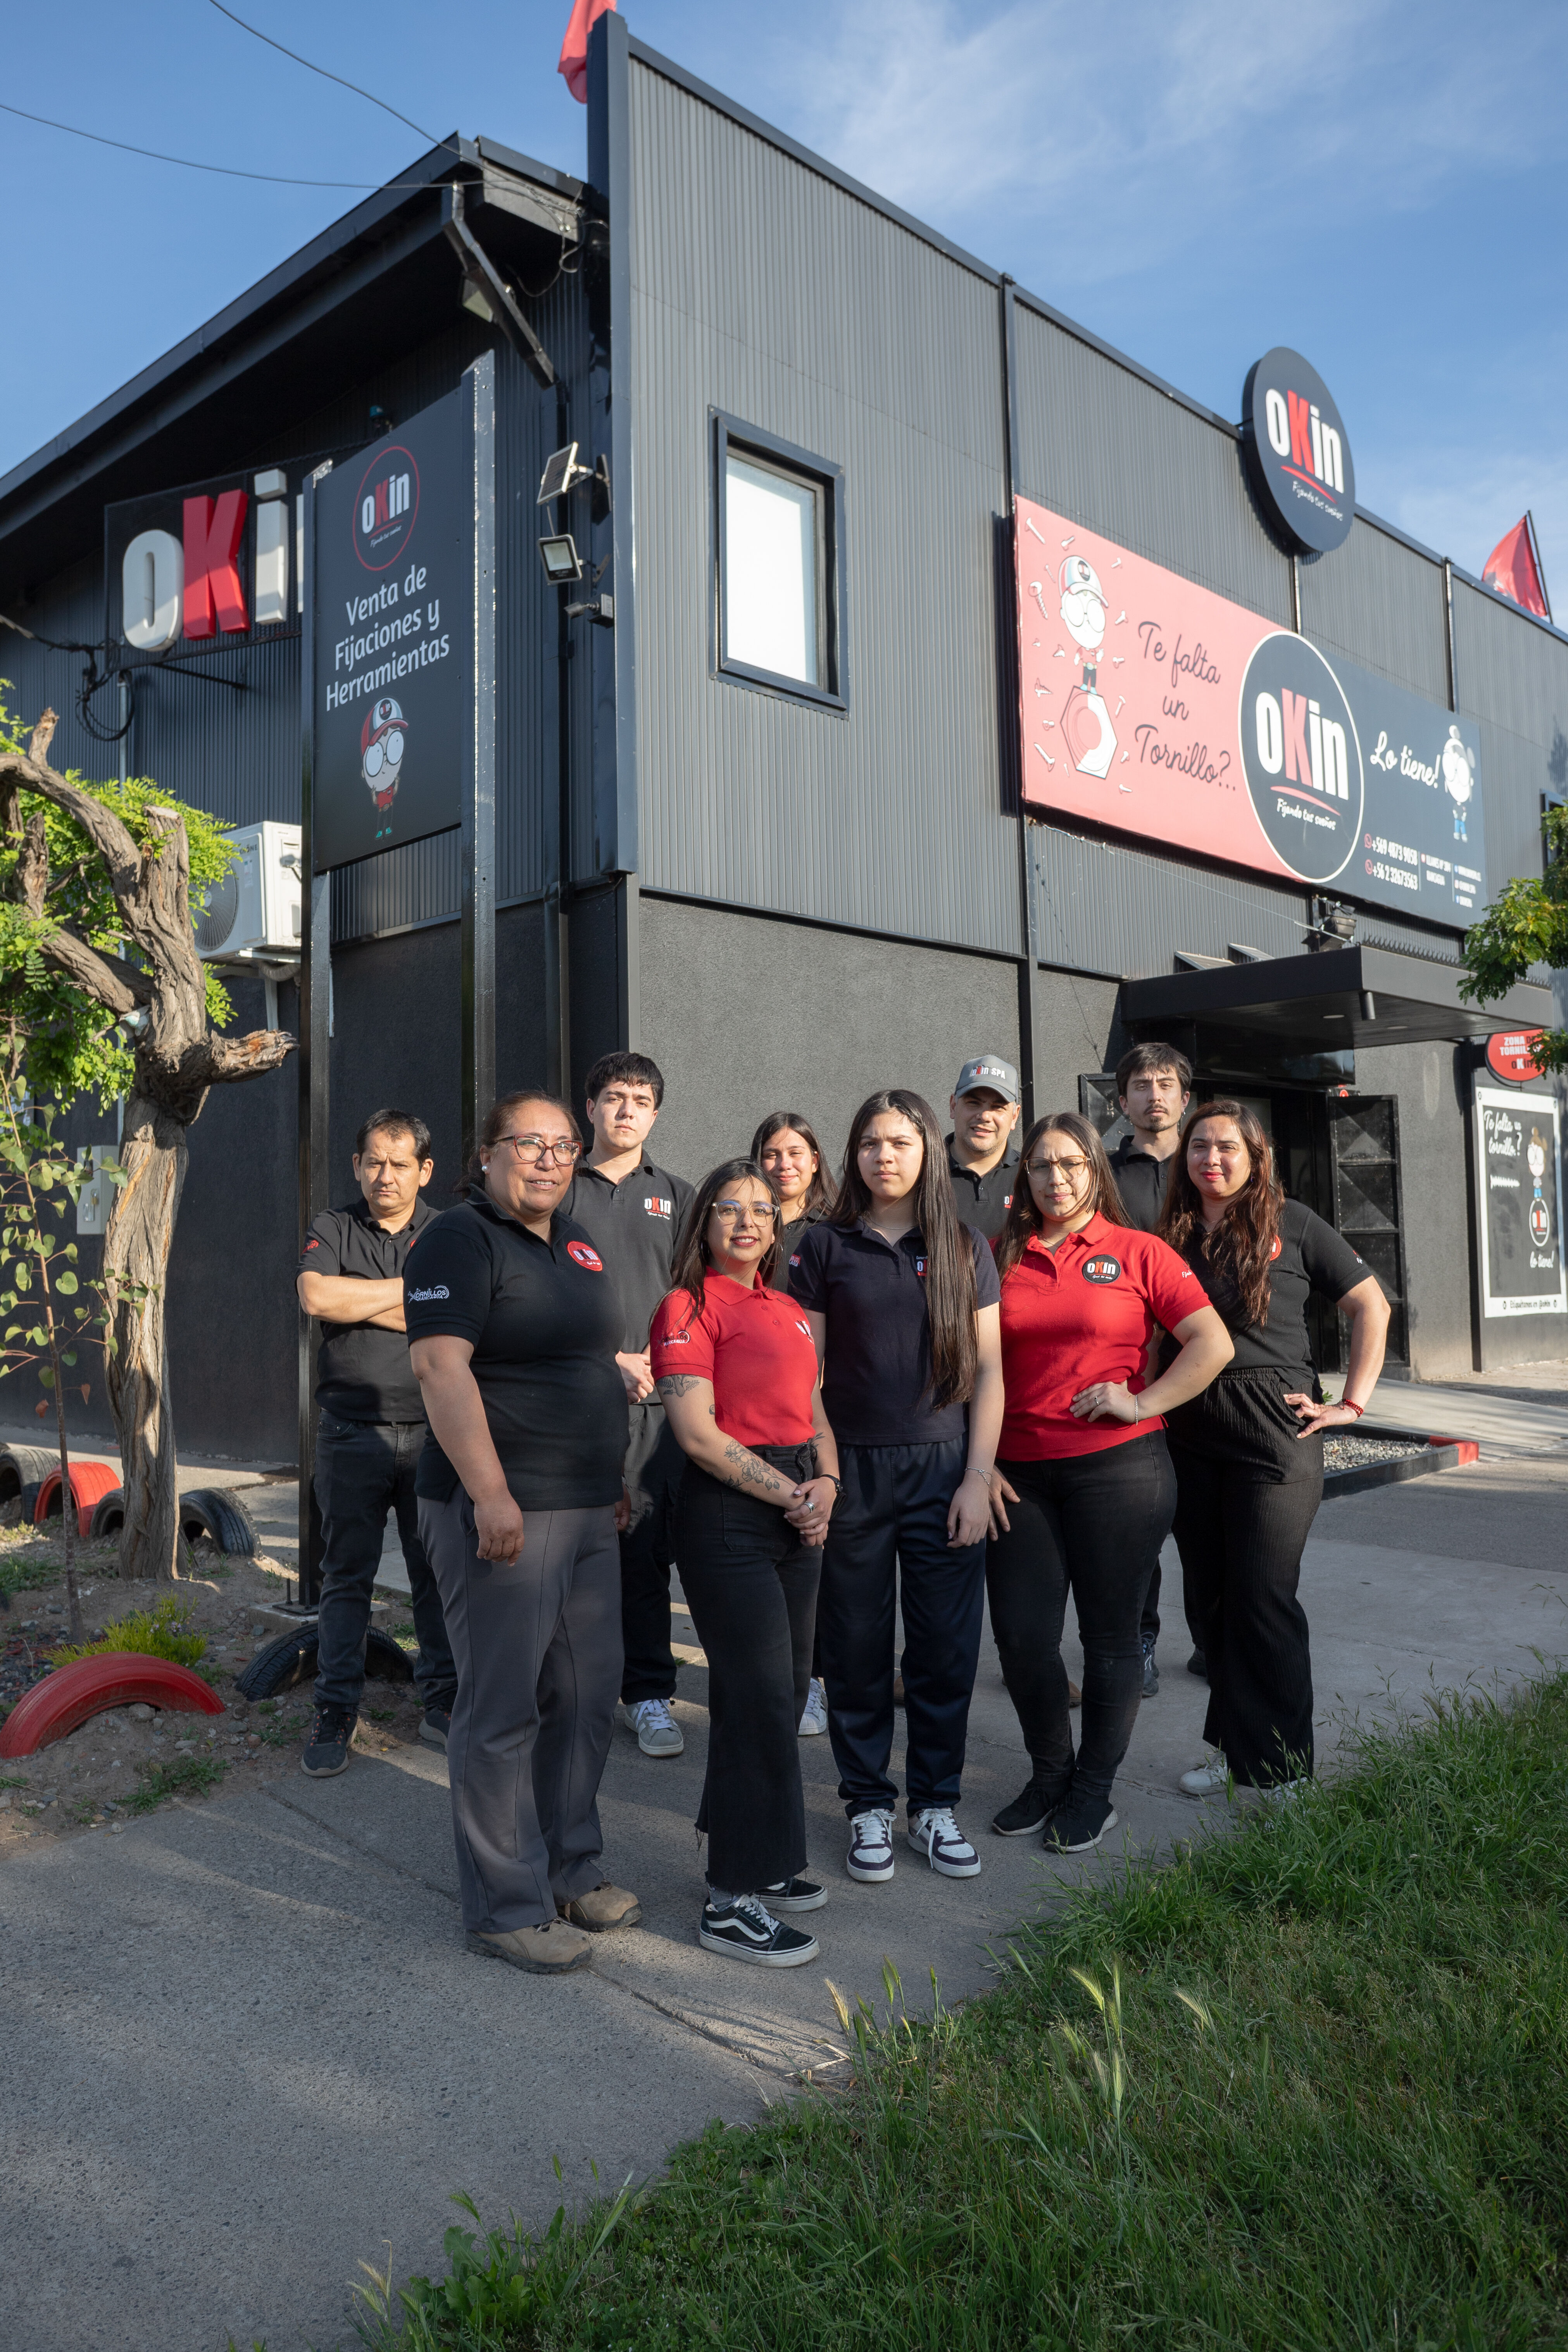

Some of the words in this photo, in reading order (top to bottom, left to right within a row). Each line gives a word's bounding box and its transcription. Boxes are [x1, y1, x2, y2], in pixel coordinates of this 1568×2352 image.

[346, 583, 399, 626] Venta
[404, 564, 427, 597] de
[335, 608, 422, 672] Fijaciones
[428, 599, 440, 631] y
[1138, 621, 1167, 662] Te
[1171, 634, 1221, 688] falta
[326, 634, 450, 712] Herramientas
[1163, 696, 1189, 721] un
[1370, 731, 1398, 772] Lo
[1400, 745, 1441, 789] tiene!
[1277, 798, 1302, 819] Fijando
[1302, 809, 1314, 823] tus
[1314, 815, 1336, 831] sueños
[1385, 865, 1390, 881] 2
[1504, 1036, 1525, 1046] ZONA
[991, 1067, 1006, 1079] SPA
[1484, 1110, 1495, 1130] Te
[1494, 1112, 1513, 1140] falta
